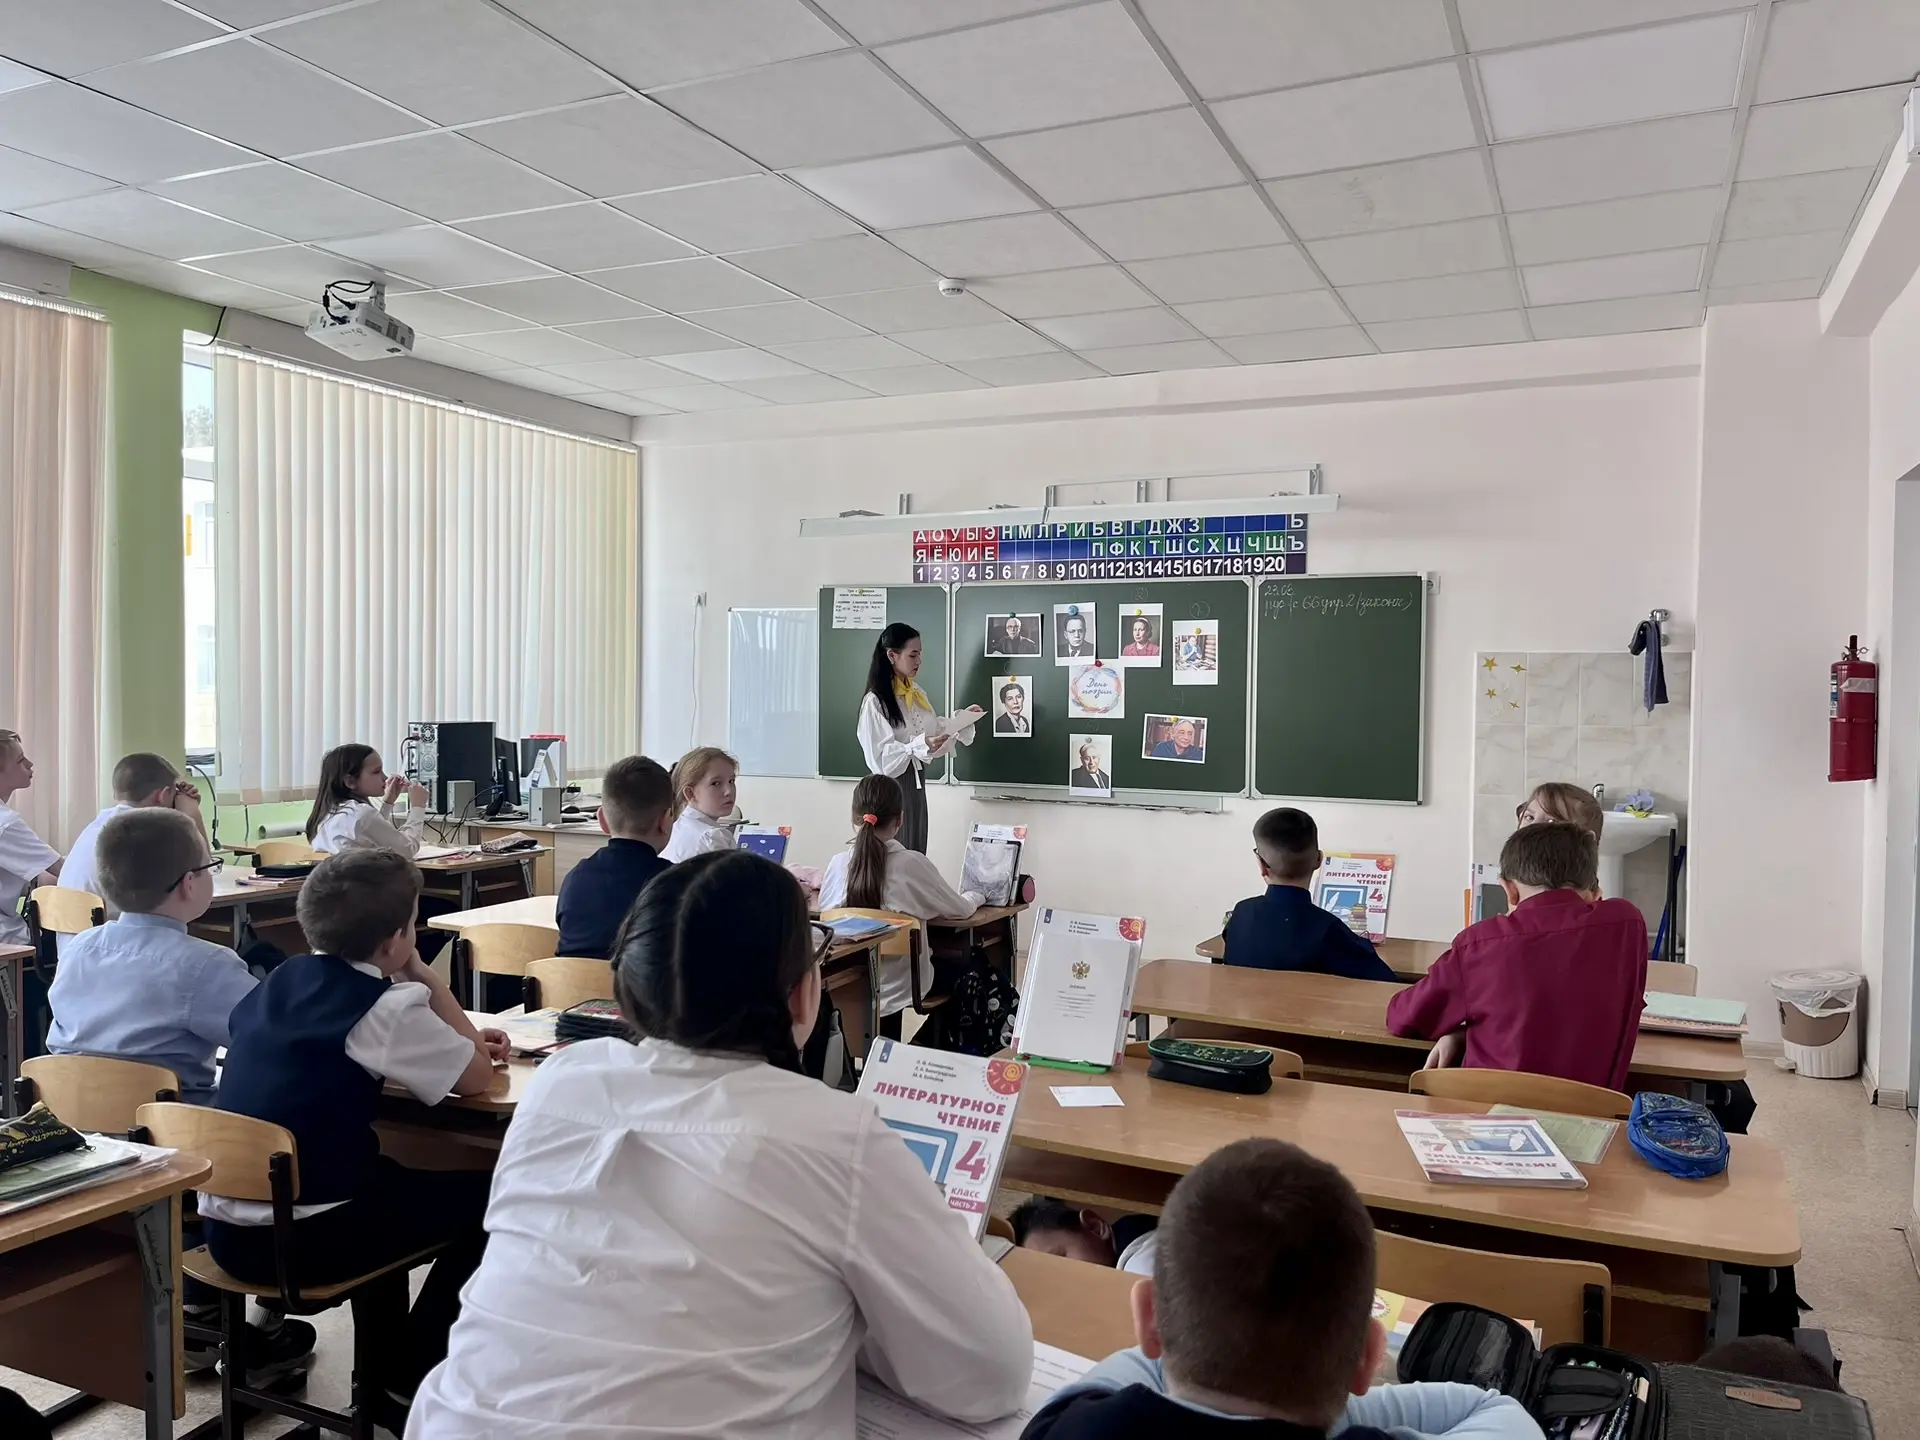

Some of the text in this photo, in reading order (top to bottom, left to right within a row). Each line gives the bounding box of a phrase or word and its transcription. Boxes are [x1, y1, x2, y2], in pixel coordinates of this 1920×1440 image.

[915, 532, 926, 542] А
[932, 530, 943, 541] О
[949, 530, 960, 541] У
[966, 528, 979, 540] Ы
[985, 528, 995, 539] Э
[1002, 528, 1012, 539] Н
[1019, 526, 1031, 538] М
[1037, 525, 1049, 537] Л
[1057, 525, 1066, 537] Р
[1112, 522, 1123, 534] В
[1131, 522, 1140, 534] Г
[1148, 520, 1161, 534] Д
[1167, 519, 1183, 533] Ж
[1189, 518, 1199, 532] З
[916, 536, 1304, 562] Я Ё Ю И Е П Ф К Т Ш С Х Ц Ч Щ Ъ
[917, 557, 1284, 580] 1 2 3 4 5 6 7 8 9 10 11 12 13 14 15 16 17 18 19 20
[1086, 677, 1108, 687] День
[1082, 689, 1112, 699] поэзии
[1369, 888, 1383, 902] 4
[873, 1082, 1006, 1116] ЛИТЕРАТУРНОЕ
[937, 1111, 1001, 1133] ЧТЕНИЕ
[955, 1140, 986, 1180] 4
[951, 1187, 980, 1198] класс
[949, 1199, 970, 1209] часть
